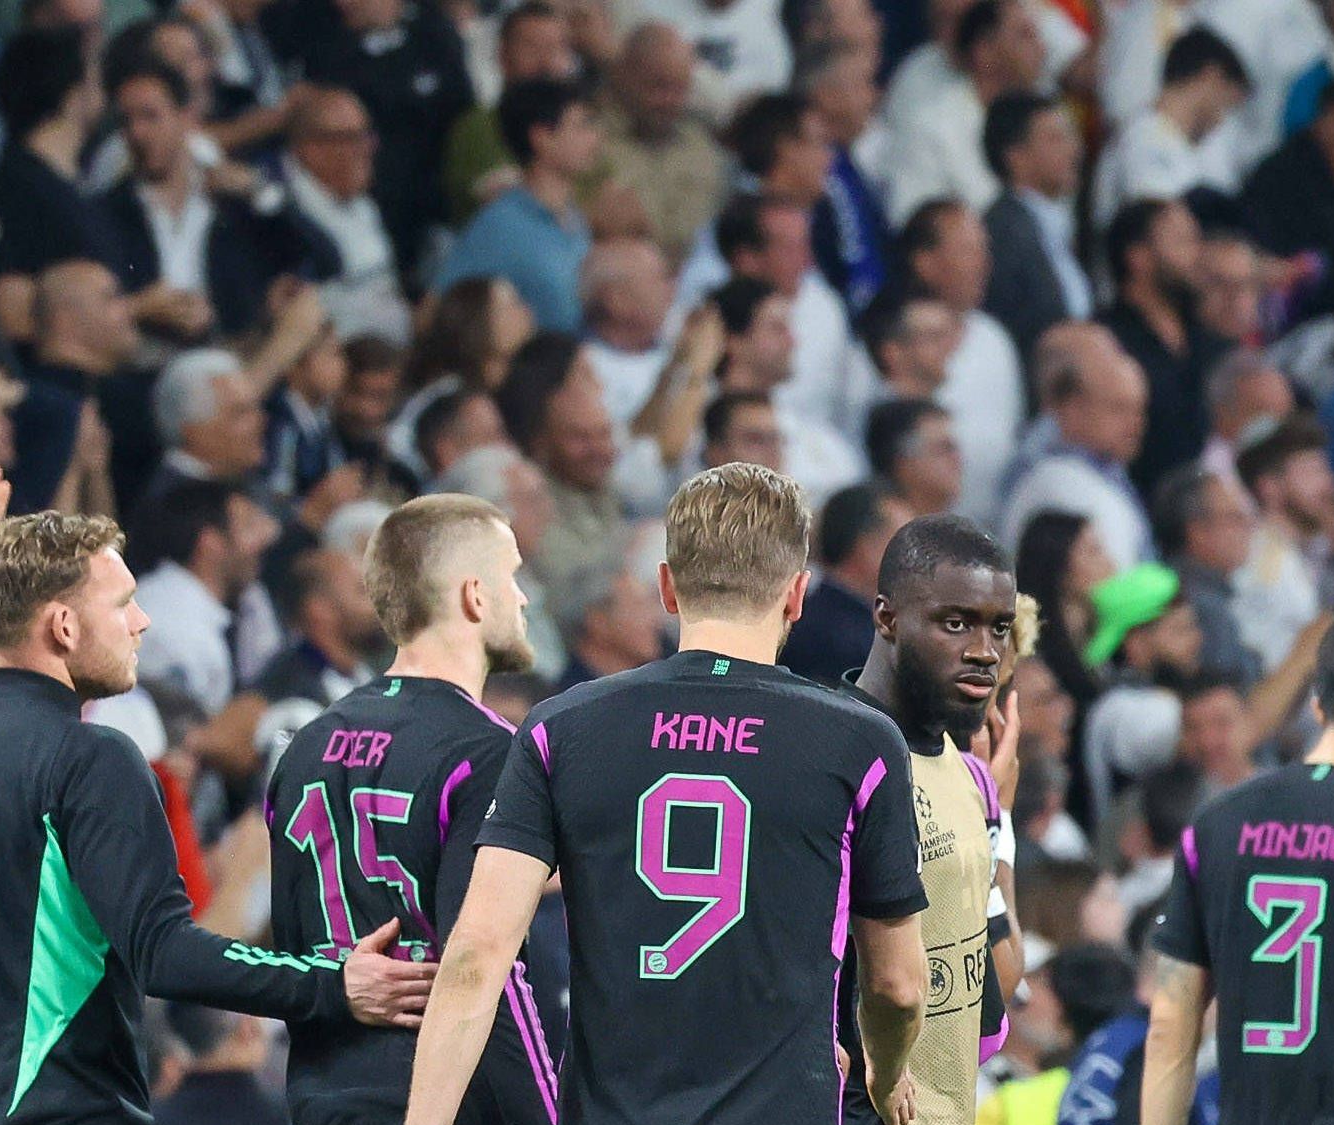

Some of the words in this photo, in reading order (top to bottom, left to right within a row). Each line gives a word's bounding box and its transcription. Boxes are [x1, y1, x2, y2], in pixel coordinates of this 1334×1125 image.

[322, 729, 393, 768] DIER
[651, 711, 764, 755] KANE
[918, 829, 956, 852] AMPIONS
[921, 844, 954, 863] LEAGUE
[284, 780, 439, 963] 15
[635, 772, 751, 980] 9
[1242, 873, 1329, 1055] 3
